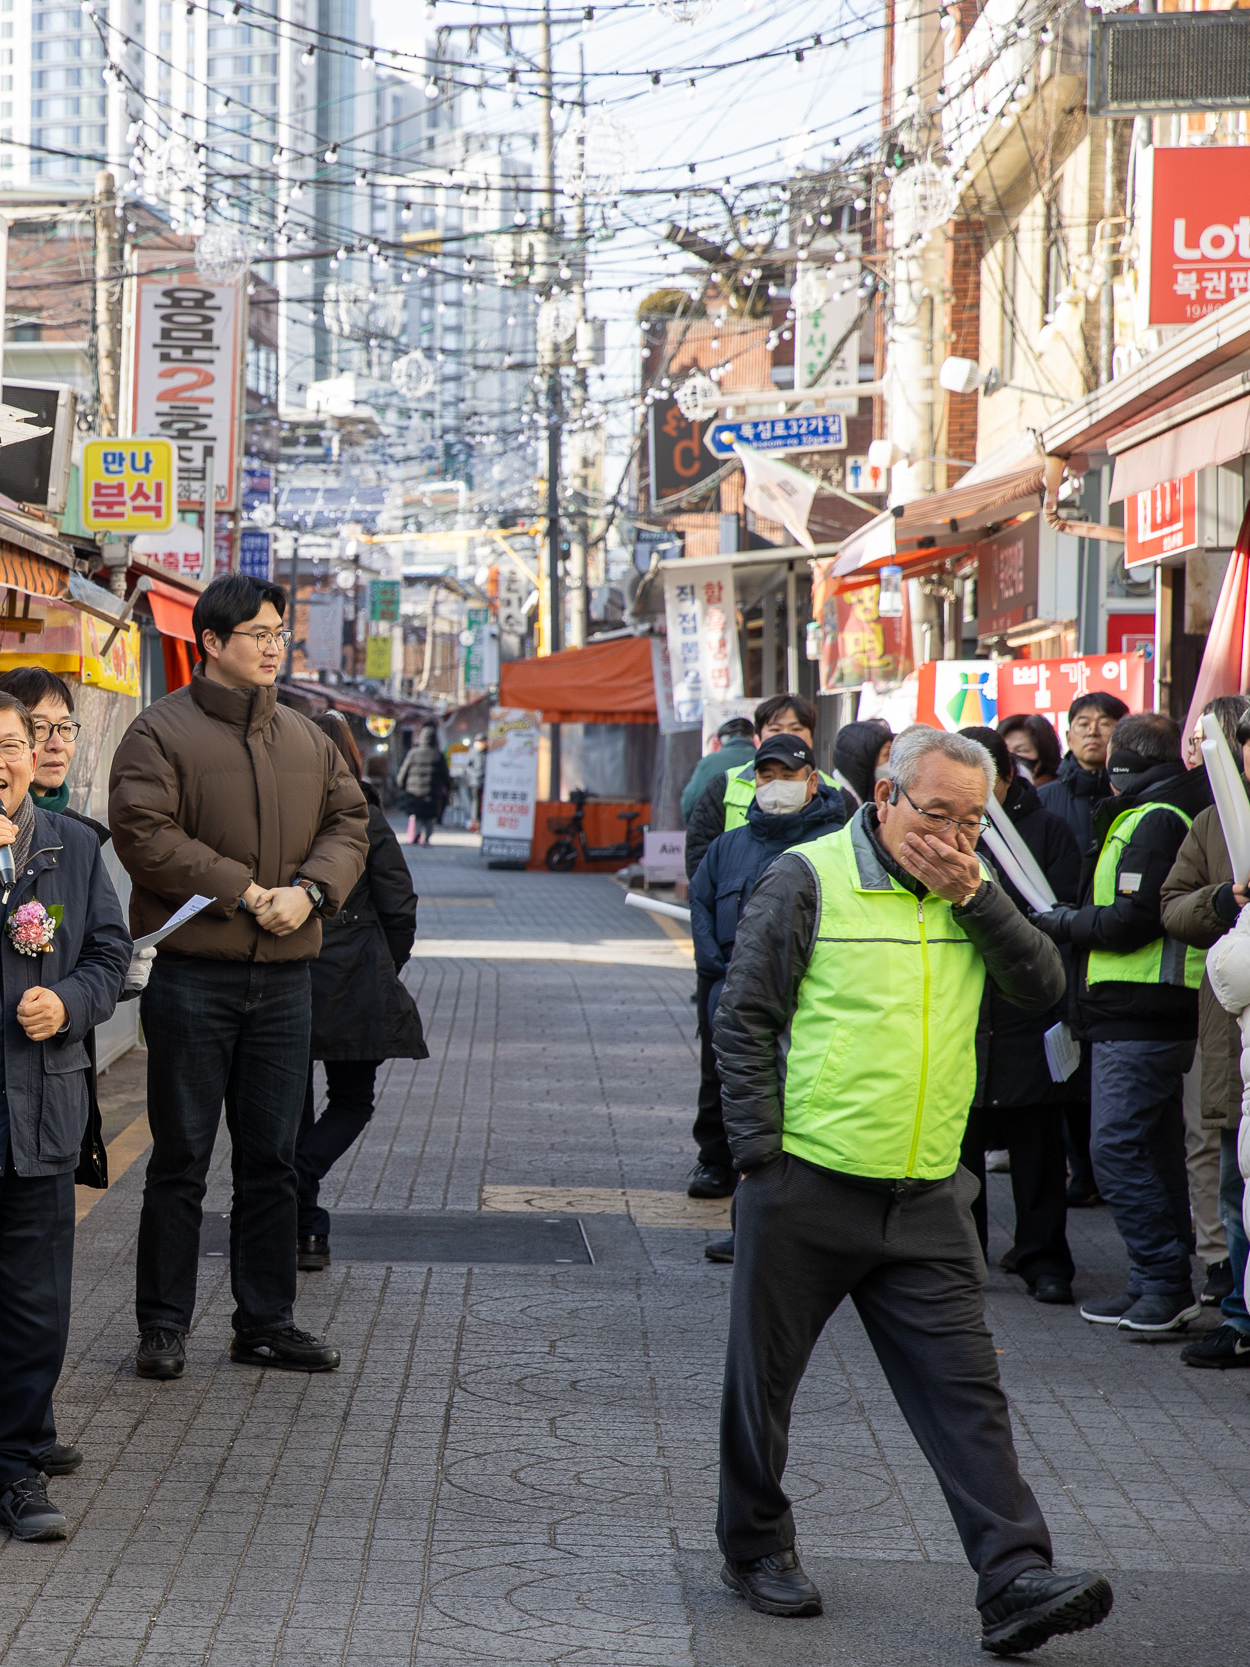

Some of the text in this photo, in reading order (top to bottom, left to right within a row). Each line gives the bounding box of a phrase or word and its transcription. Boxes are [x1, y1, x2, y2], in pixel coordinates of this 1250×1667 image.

[739, 415, 840, 441] 뚝섬로32가길
[102, 451, 153, 475] 만나
[91, 481, 163, 520] 분식
